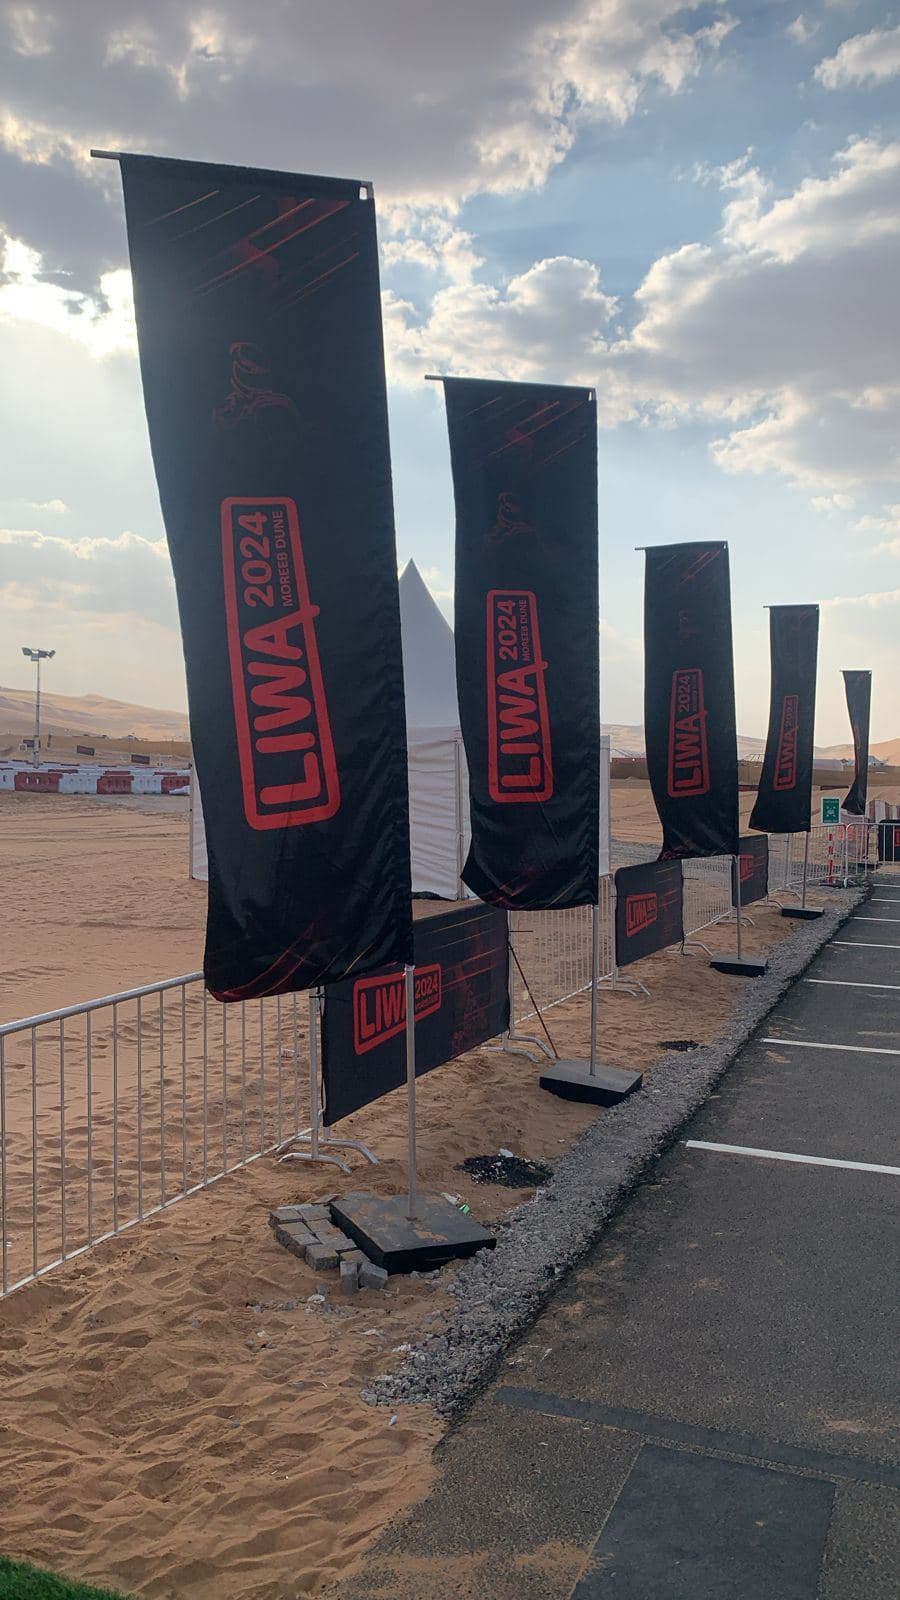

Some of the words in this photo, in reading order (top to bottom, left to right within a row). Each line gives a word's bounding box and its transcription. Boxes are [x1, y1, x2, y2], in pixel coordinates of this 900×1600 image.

[272, 511, 287, 549] DUNE
[238, 511, 275, 608] 2024
[277, 551, 294, 608] MOREEB
[496, 600, 519, 661] 2024
[519, 599, 528, 624] DUNE
[521, 625, 531, 662] MOREEB
[244, 604, 321, 805] LIWA
[678, 674, 690, 713] 2024
[497, 660, 549, 788] LIWA
[675, 709, 708, 788] LIWA
[779, 726, 799, 785] LIWA
[415, 972, 438, 1000] 2024
